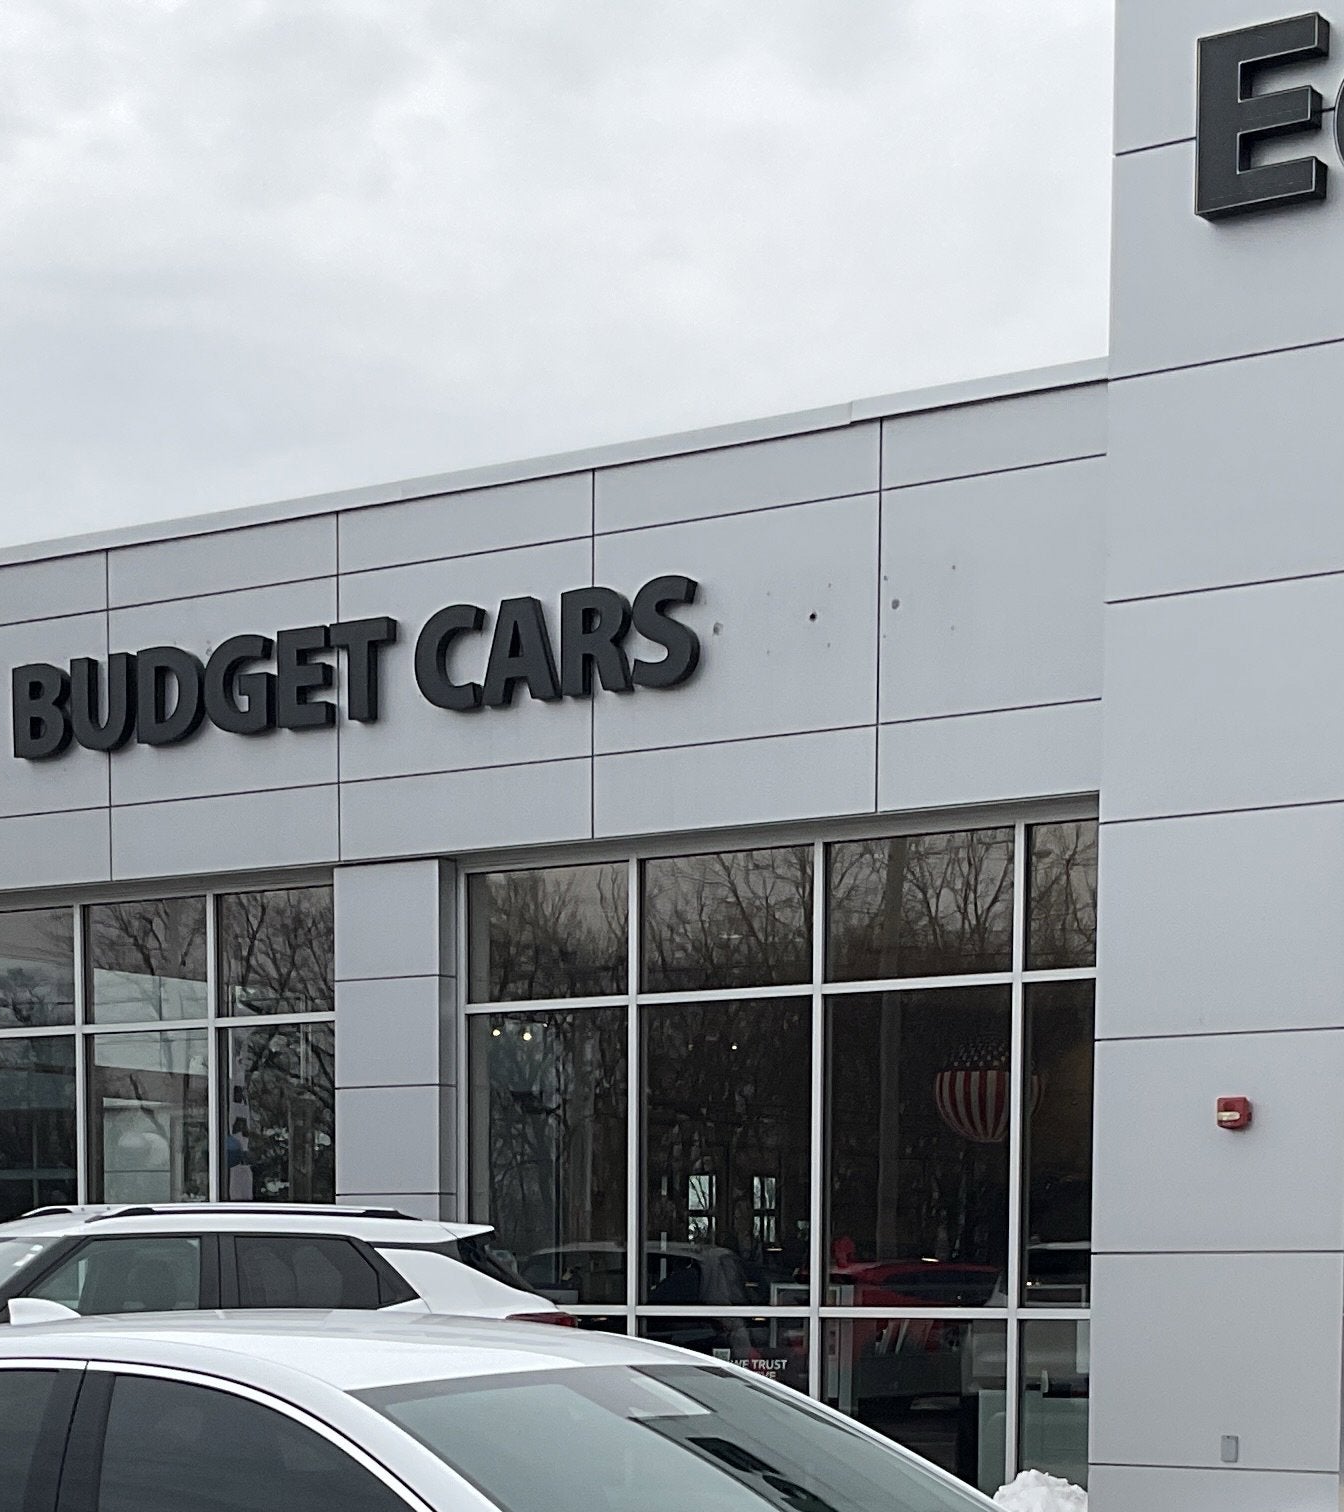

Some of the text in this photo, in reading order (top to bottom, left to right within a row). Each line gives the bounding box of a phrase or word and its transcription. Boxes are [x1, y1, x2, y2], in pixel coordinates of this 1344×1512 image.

[12, 575, 701, 759] BUDGET CARS
[751, 1359, 787, 1370] TRUST
